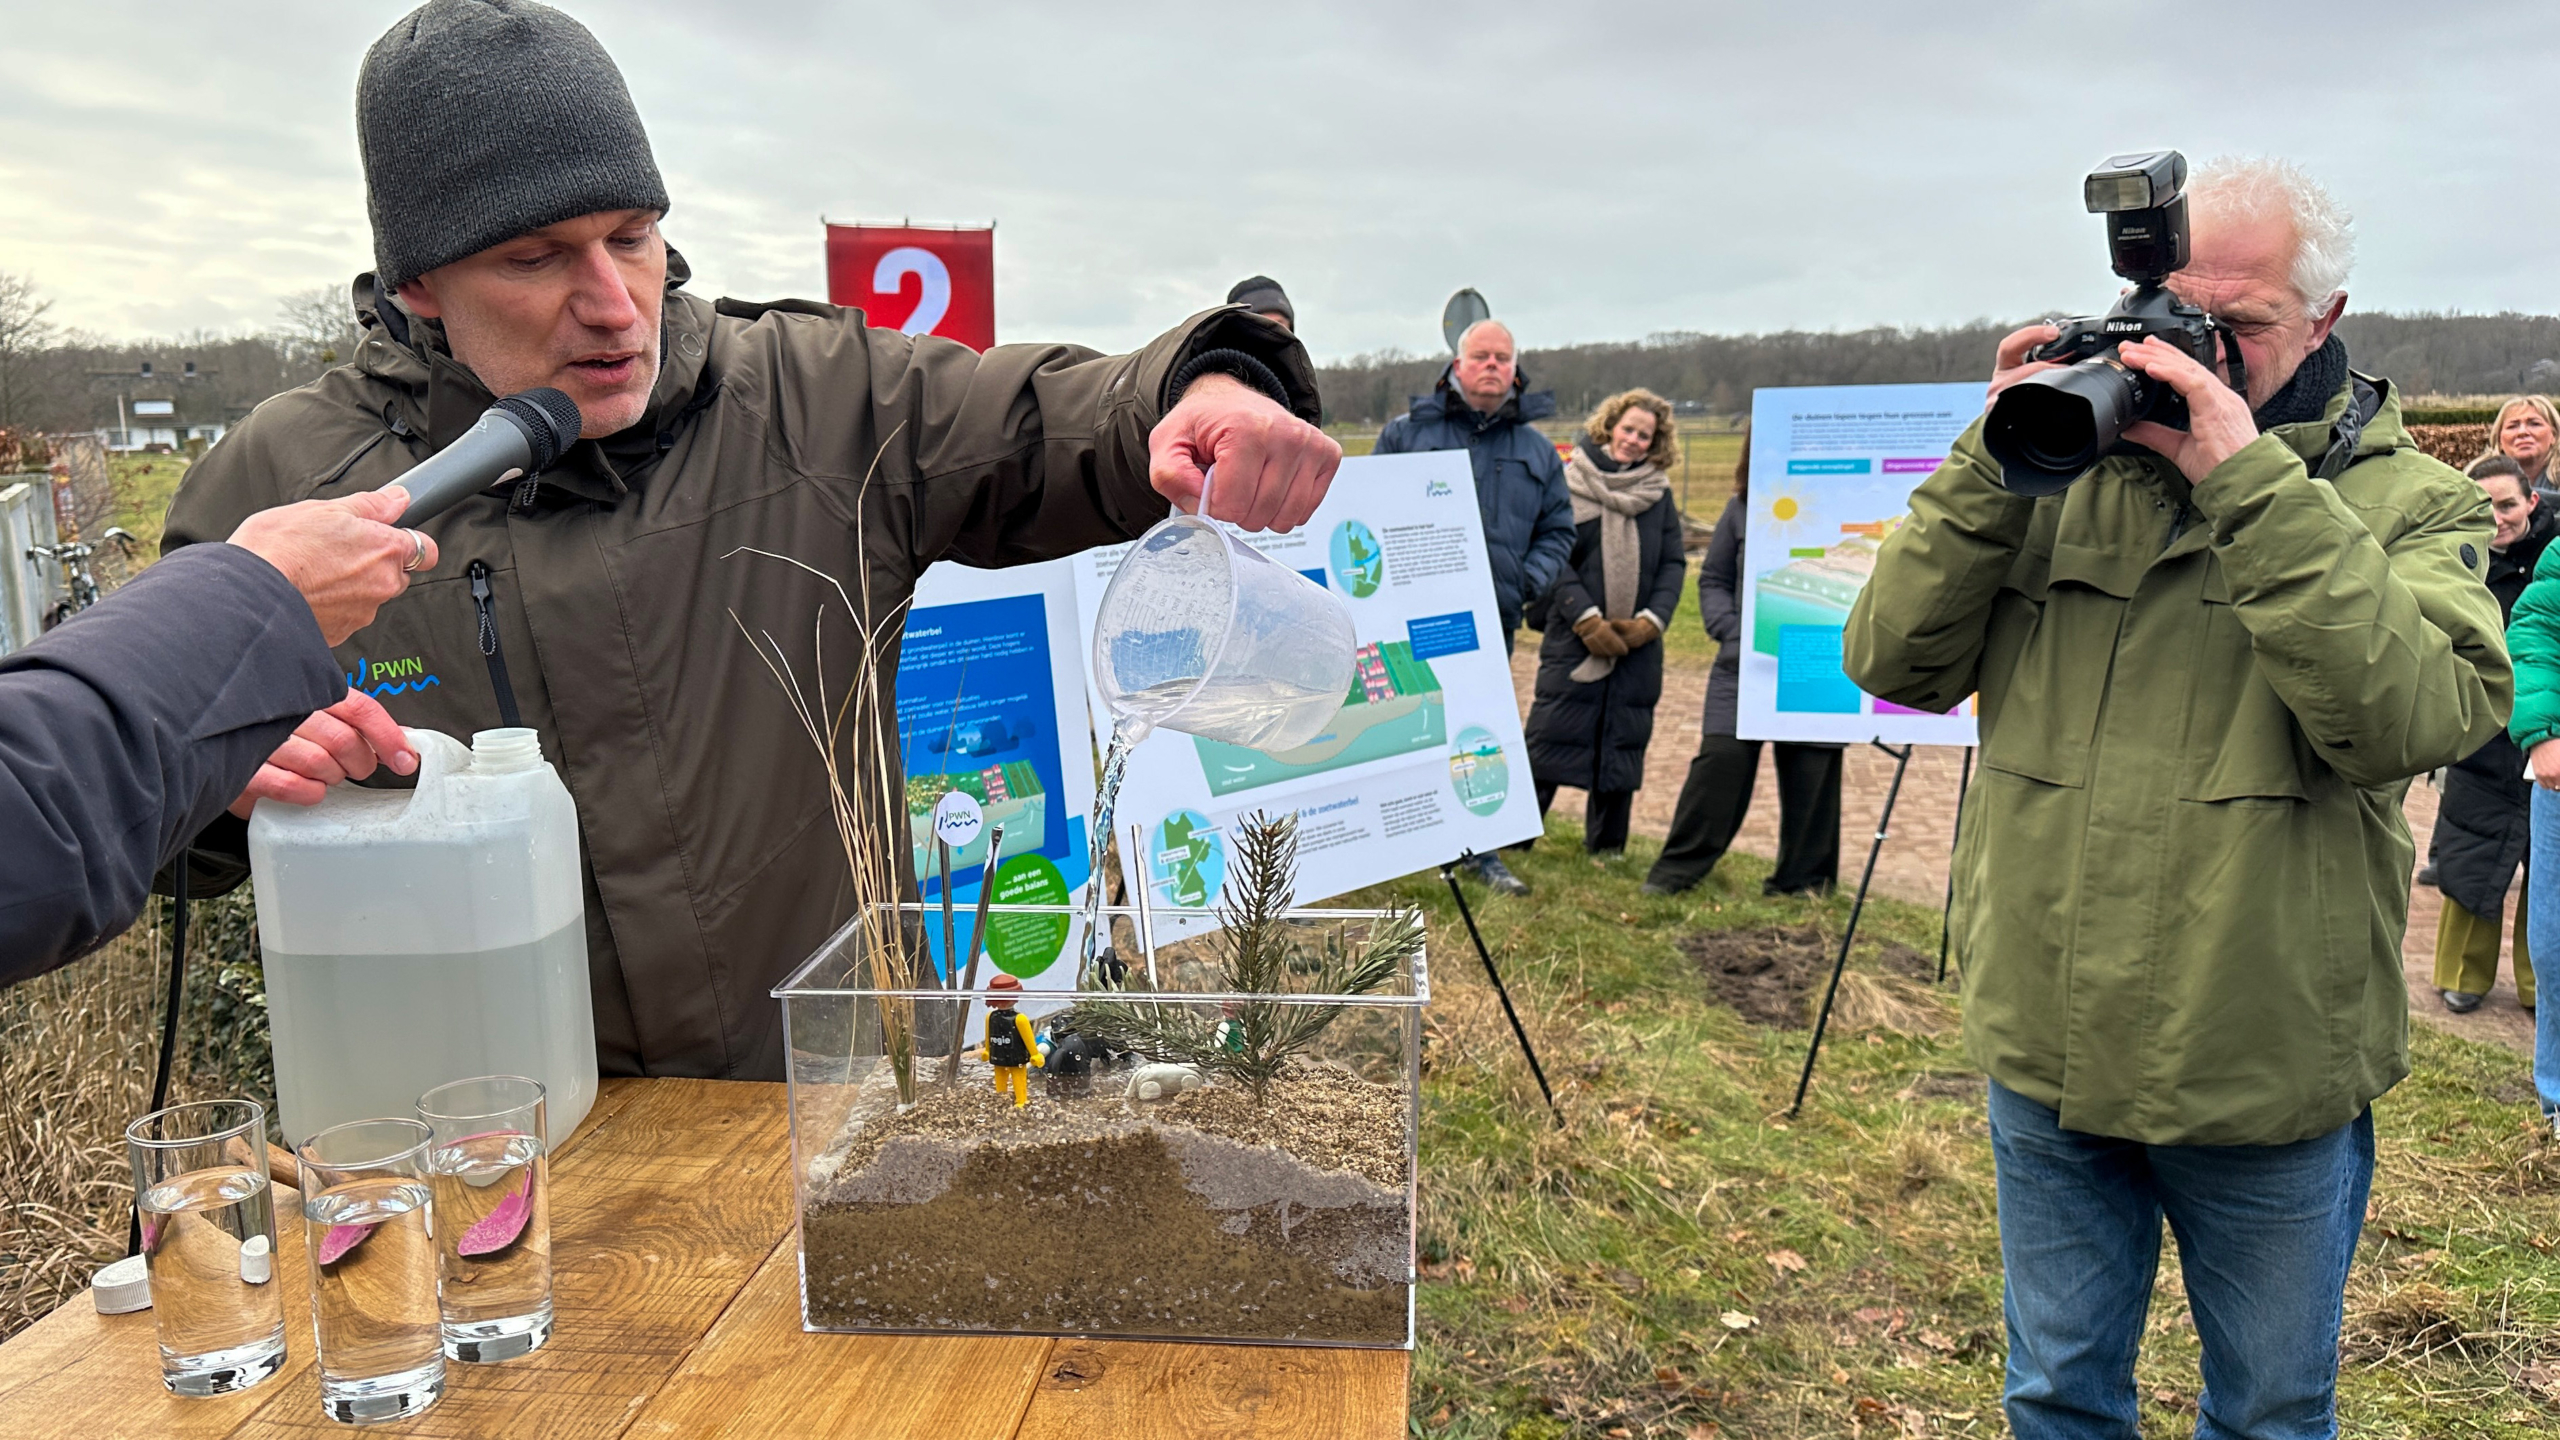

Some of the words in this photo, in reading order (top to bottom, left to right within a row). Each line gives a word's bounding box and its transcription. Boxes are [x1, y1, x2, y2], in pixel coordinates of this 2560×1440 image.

[2122, 227, 2146, 235] Nikon
[873, 246, 951, 337] 2
[2106, 321, 2142, 332] Nikon
[372, 656, 423, 681] PWN
[949, 811, 971, 821] PWN
[1308, 807, 1317, 817] de
[1013, 872, 1026, 883] aan
[1027, 868, 1042, 879] een
[999, 885, 1023, 901] goede
[1024, 878, 1049, 892] balans
[990, 1035, 1011, 1046] regie
